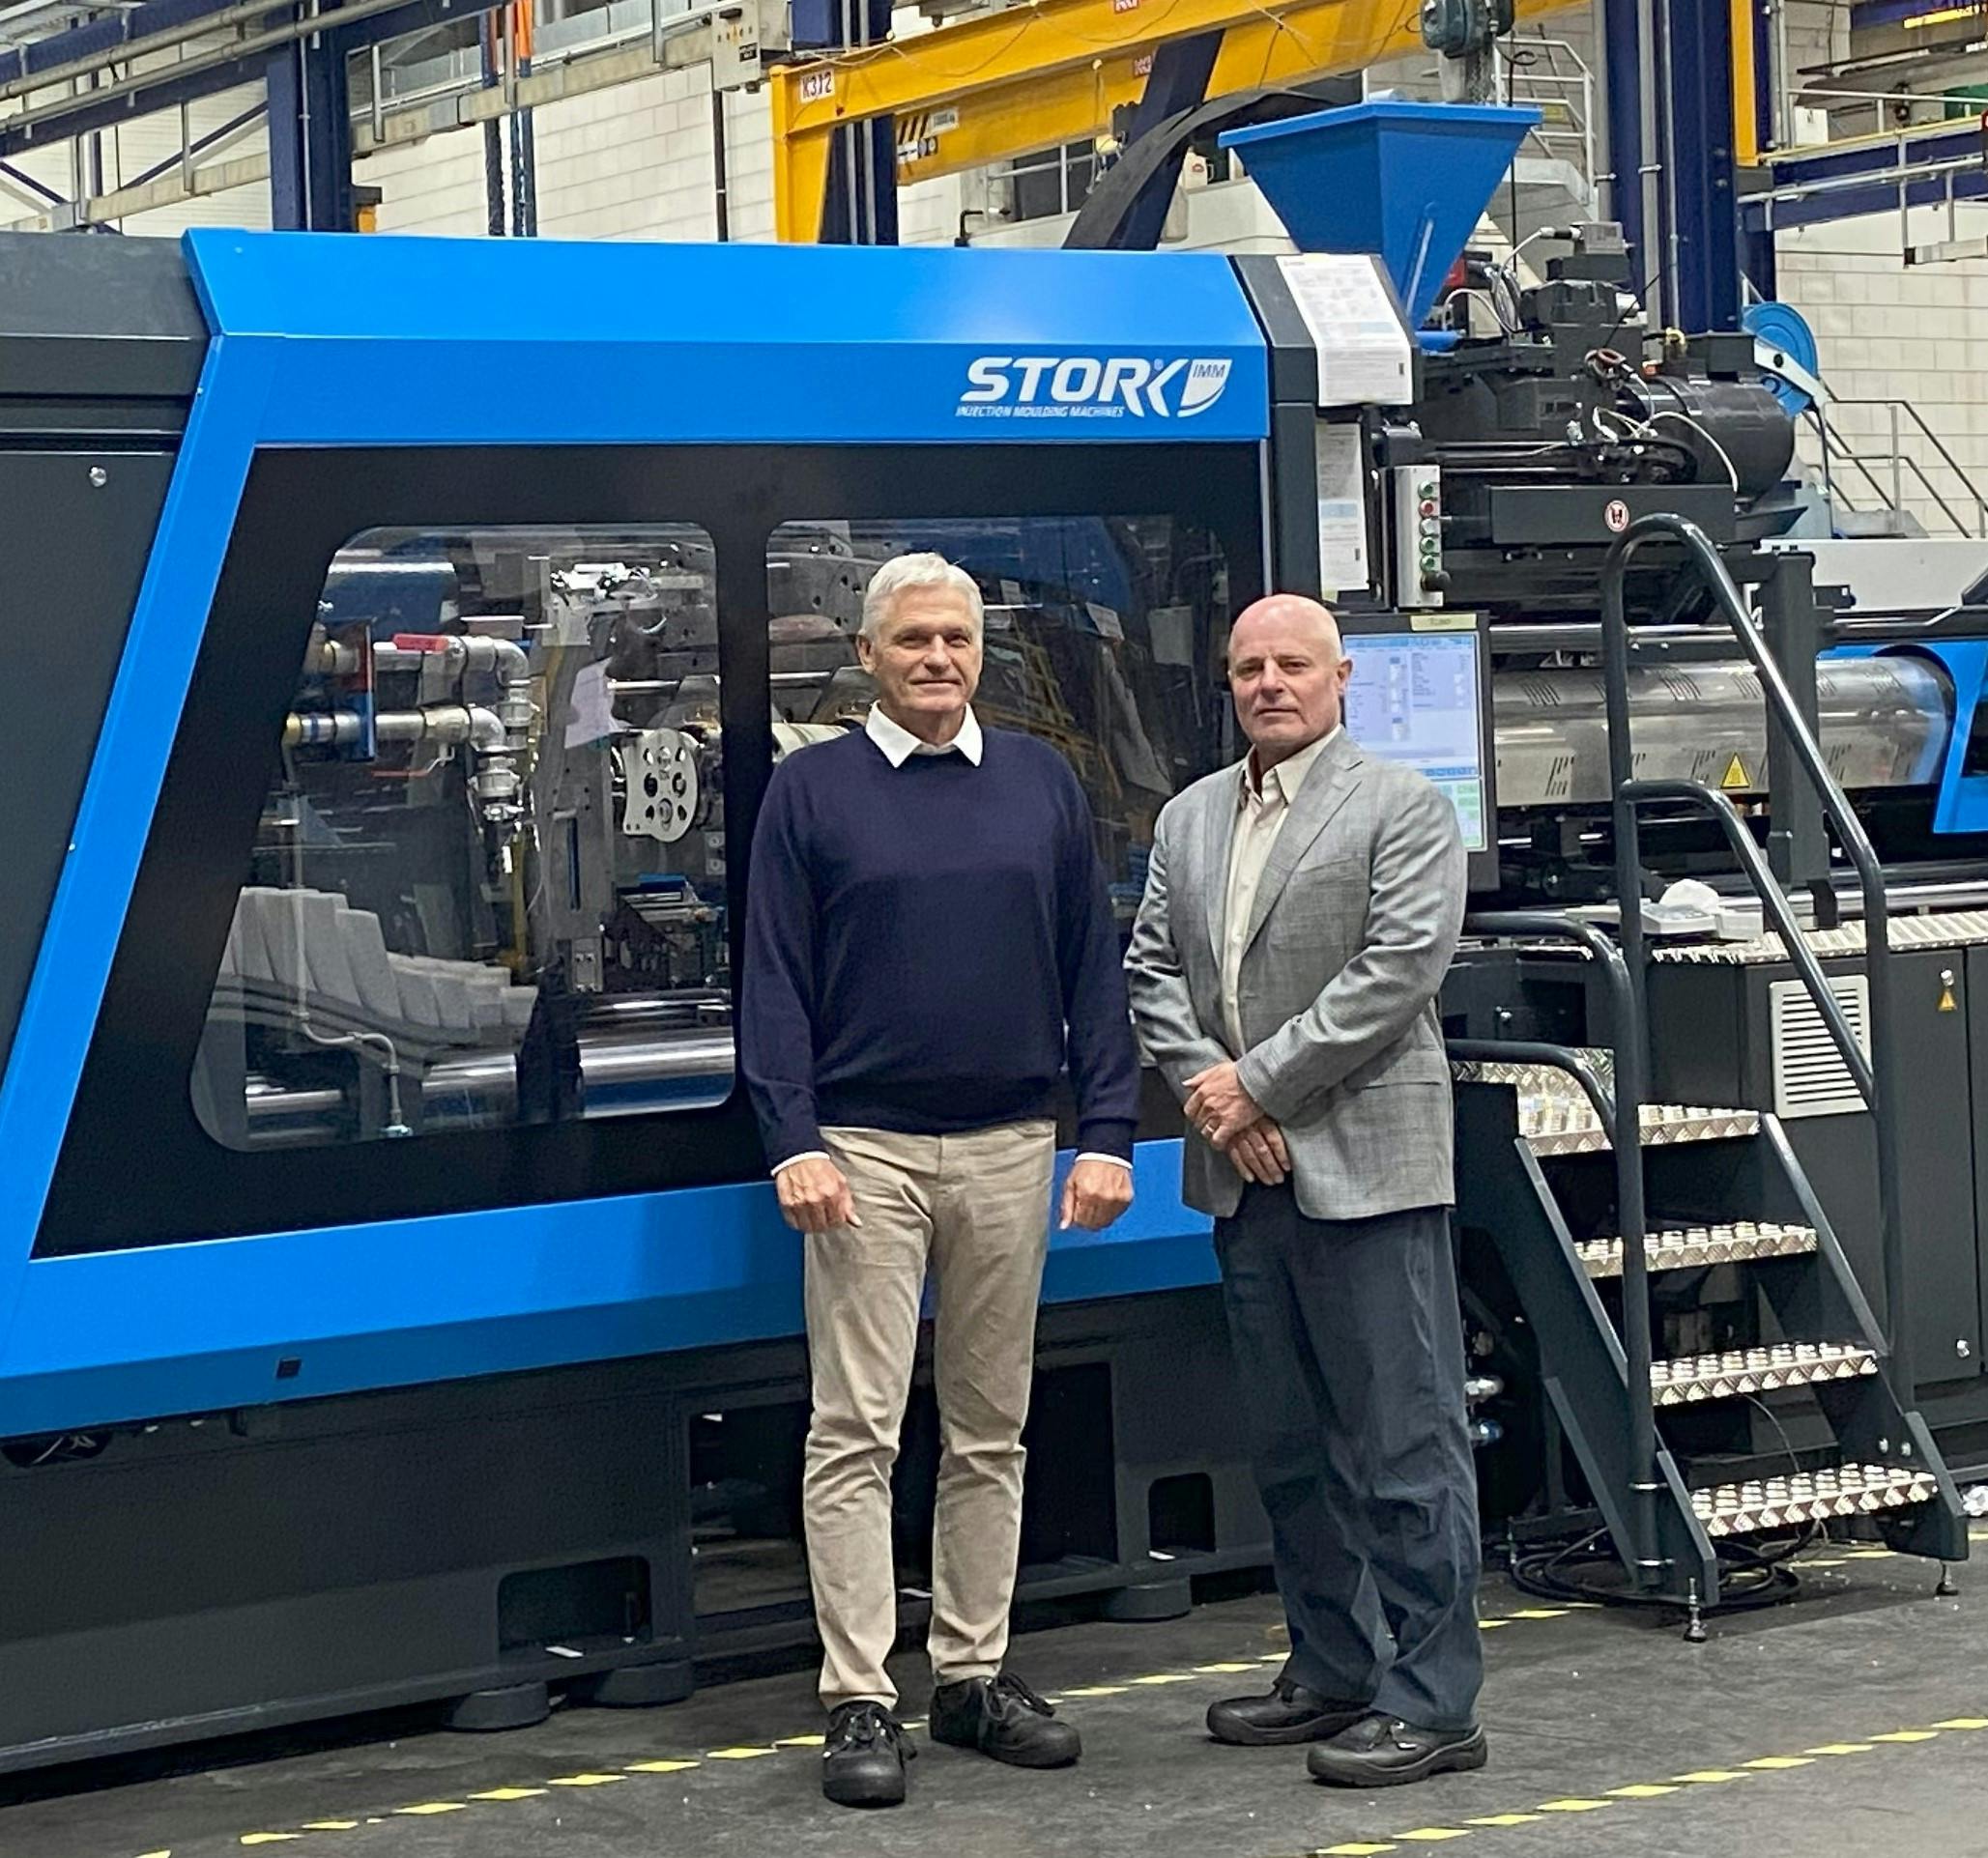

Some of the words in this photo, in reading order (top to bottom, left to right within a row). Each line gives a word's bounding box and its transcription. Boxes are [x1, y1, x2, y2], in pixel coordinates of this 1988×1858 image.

[1192, 361, 1226, 379] IMM
[955, 405, 1012, 417] INJECTION
[1013, 405, 1069, 417] MOULDING
[1070, 406, 1124, 418] MACHINES
